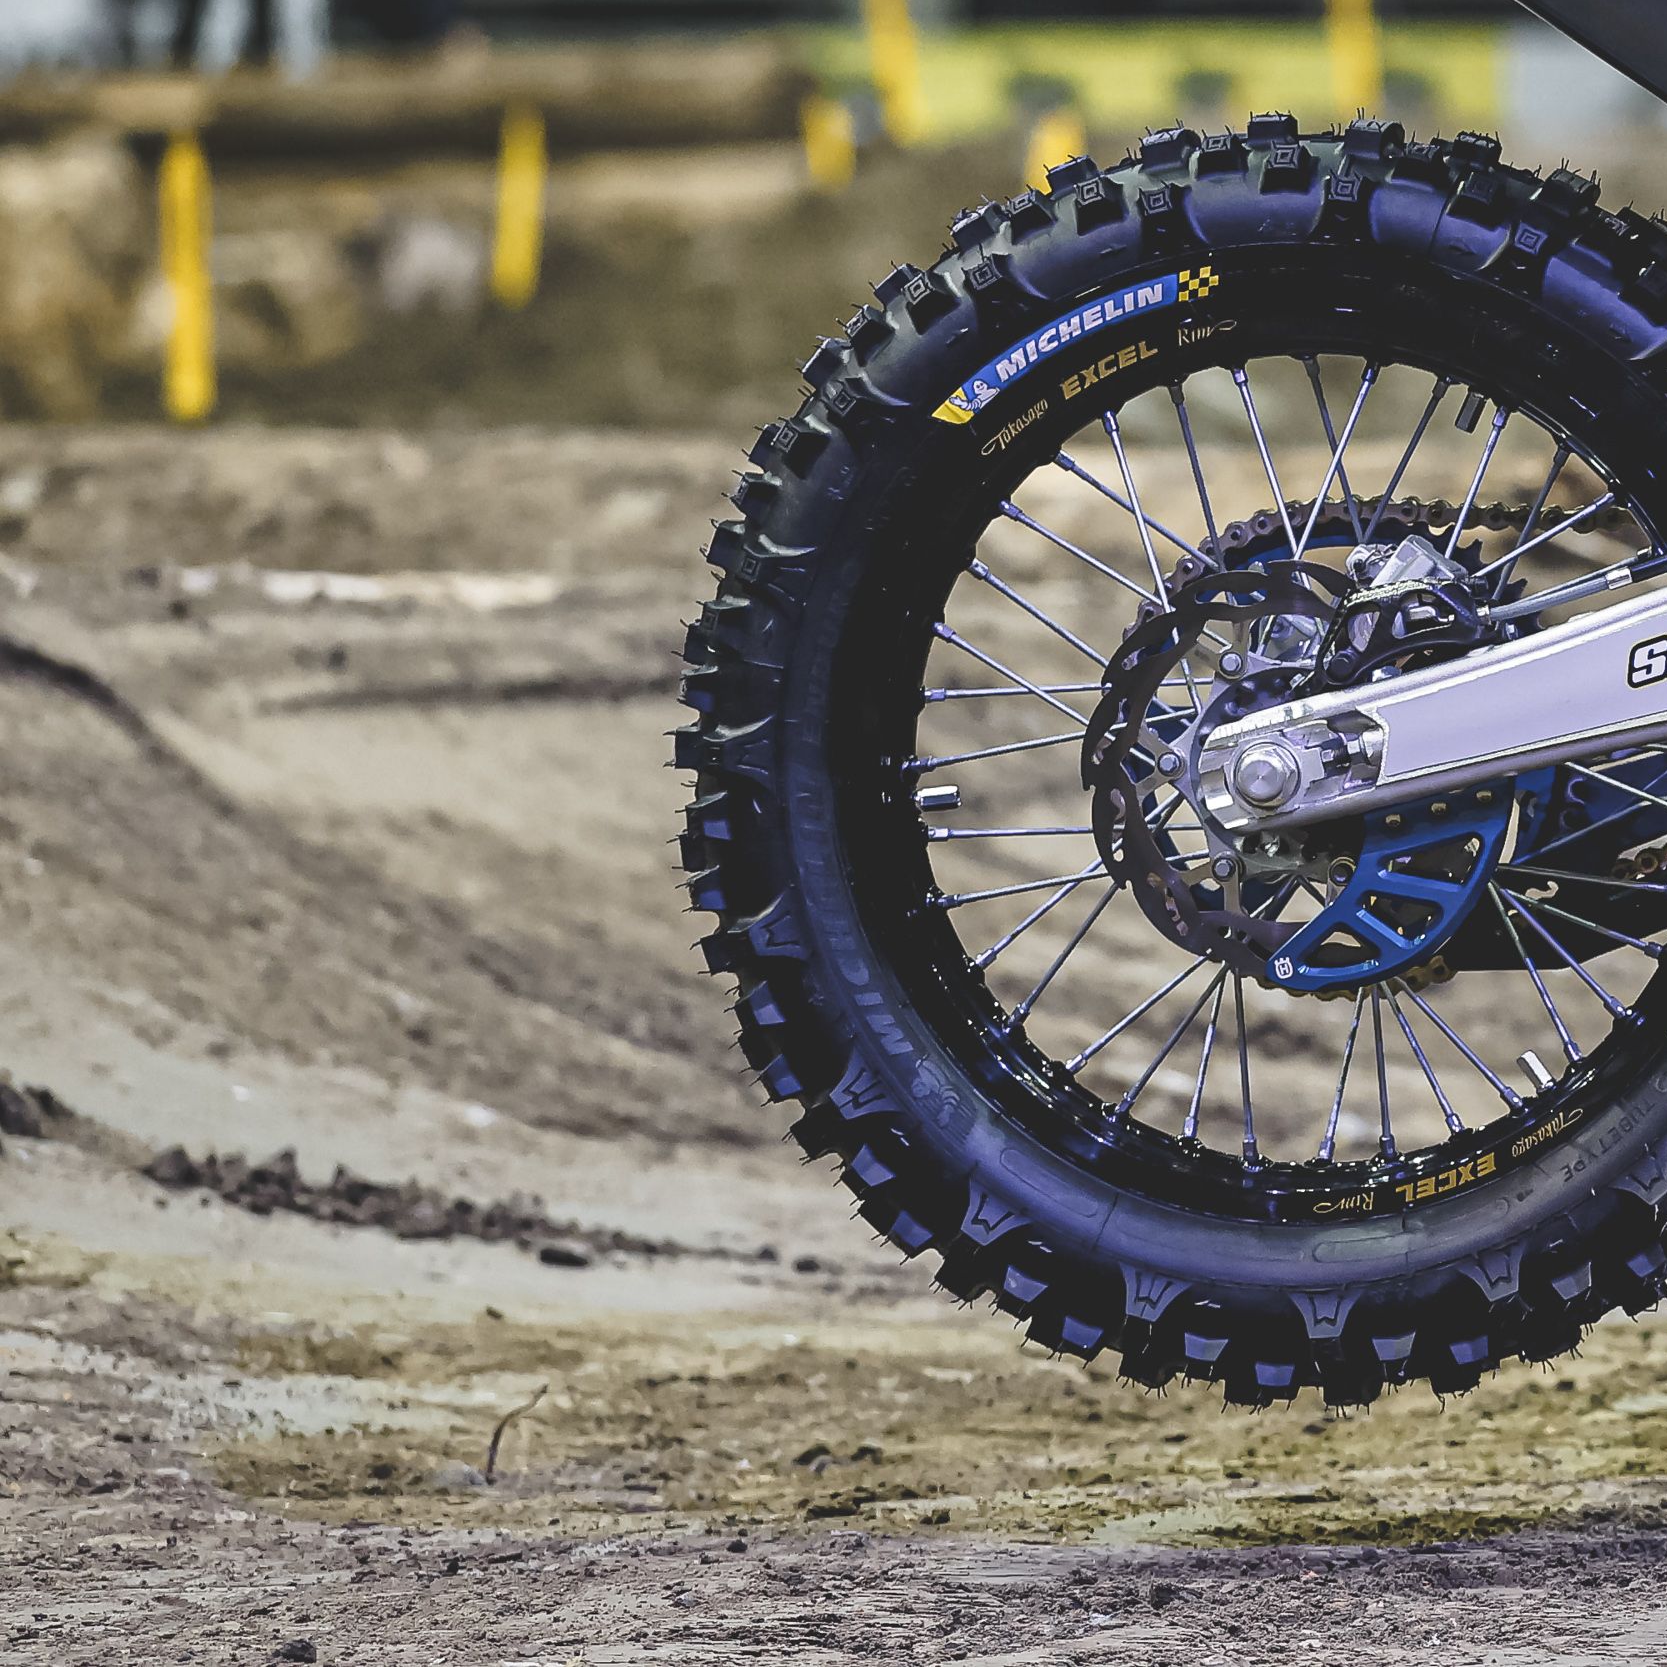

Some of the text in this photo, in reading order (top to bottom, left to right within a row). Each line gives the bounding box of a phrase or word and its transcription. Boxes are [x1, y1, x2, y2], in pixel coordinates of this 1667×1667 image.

[995, 283, 1163, 383] MICHELIN
[1060, 340, 1159, 400] EXCEL
[1395, 1151, 1497, 1203] EXCEL
